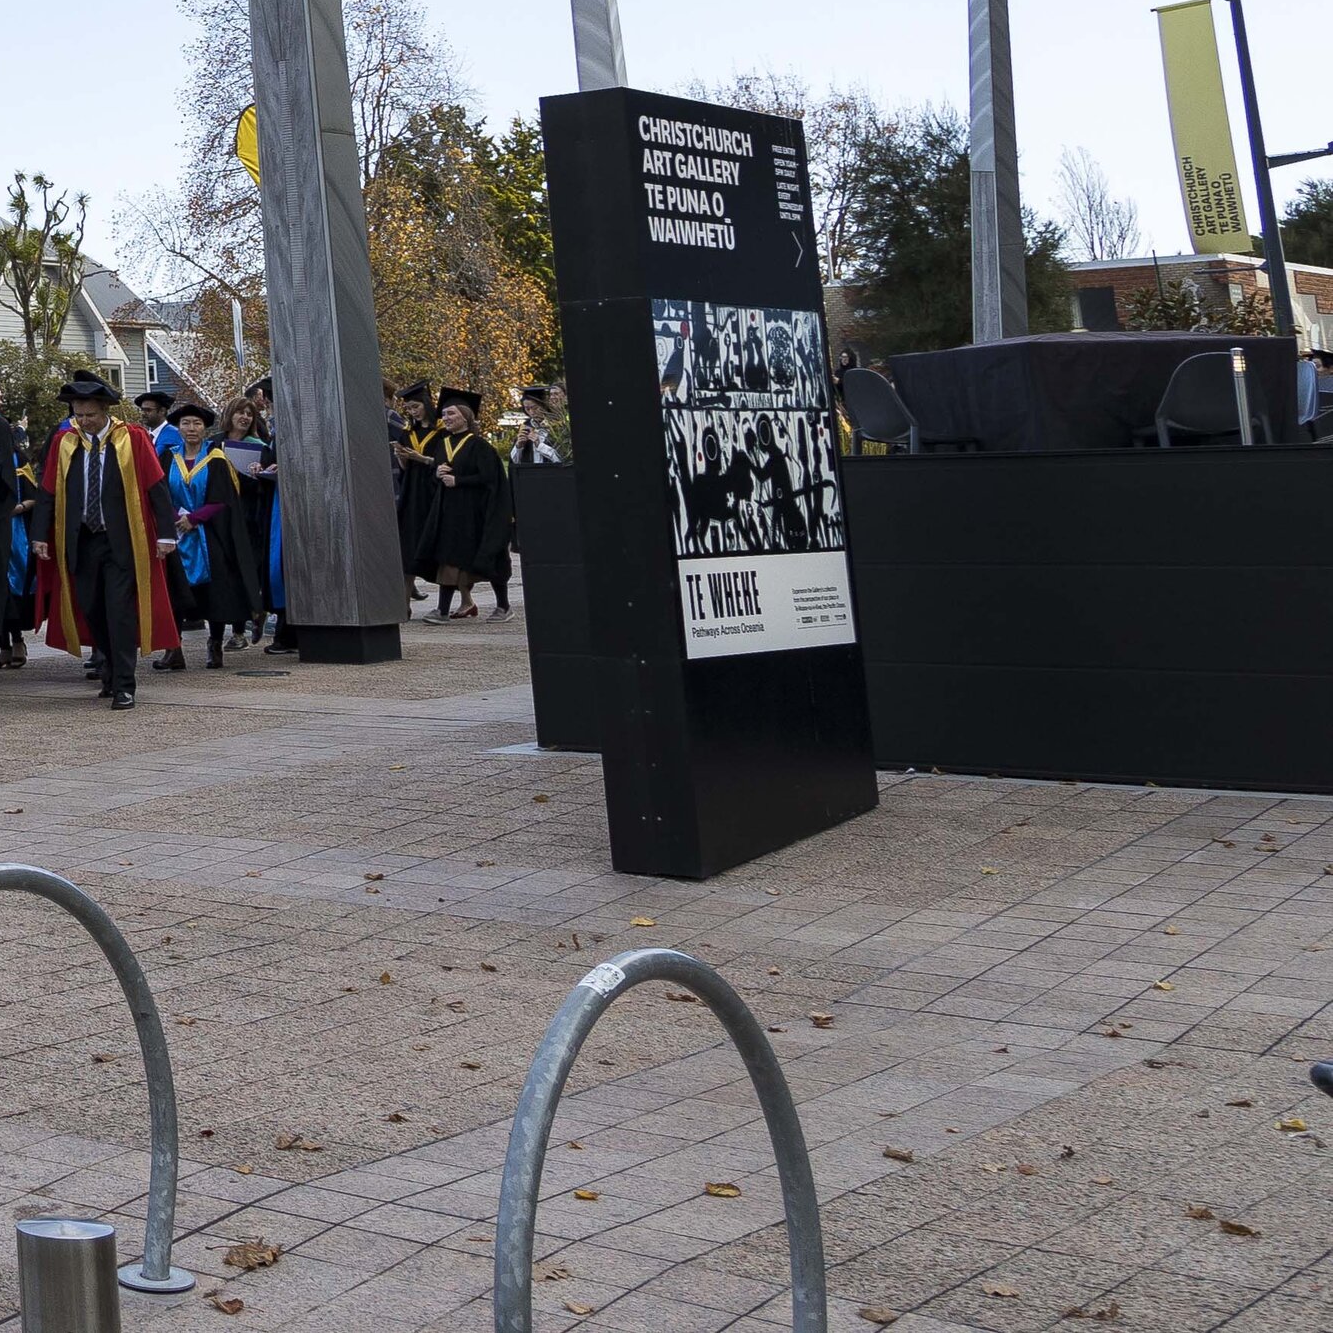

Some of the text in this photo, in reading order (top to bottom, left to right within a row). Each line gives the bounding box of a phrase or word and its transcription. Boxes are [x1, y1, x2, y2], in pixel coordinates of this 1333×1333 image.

[638, 115, 753, 157] CHRISTCHURCH
[643, 148, 740, 185] ART GALLERY
[644, 183, 724, 217] TE PUNA O
[1181, 156, 1206, 236] CHRISTCHURCH
[1195, 167, 1218, 235] ART GALLERY
[1213, 190, 1227, 219] PUNA
[1219, 172, 1242, 233] WAIWHETŪ
[648, 216, 735, 250] WAIWHETŪ
[1219, 221, 1230, 234] TE
[686, 570, 762, 620] TE WHEKE
[691, 621, 765, 638] Pathways Across Oceania
